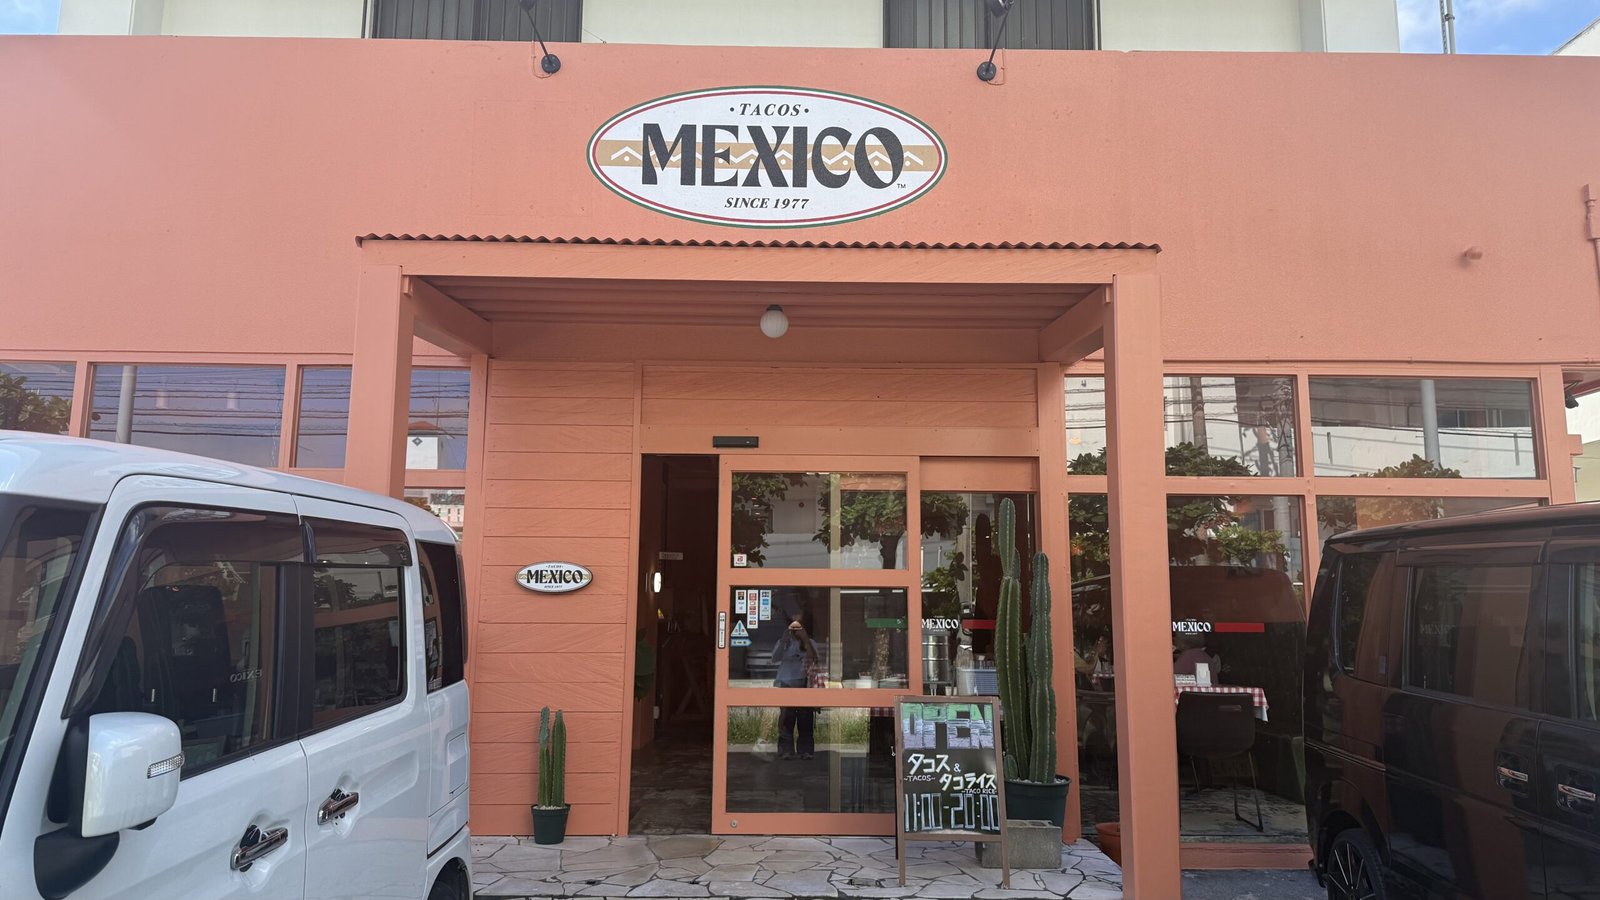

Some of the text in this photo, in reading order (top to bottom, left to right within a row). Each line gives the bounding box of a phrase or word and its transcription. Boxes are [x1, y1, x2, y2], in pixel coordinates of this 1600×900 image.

[641, 123, 904, 190] MEXICO
[724, 197, 810, 210] SINCE 1977
[526, 569, 584, 584] MEXICO
[921, 618, 959, 630] MEXICO
[1172, 621, 1212, 632] MEXICO
[902, 703, 995, 749] OPEN
[907, 753, 961, 775] タコス &
[939, 772, 997, 791] タコライス
